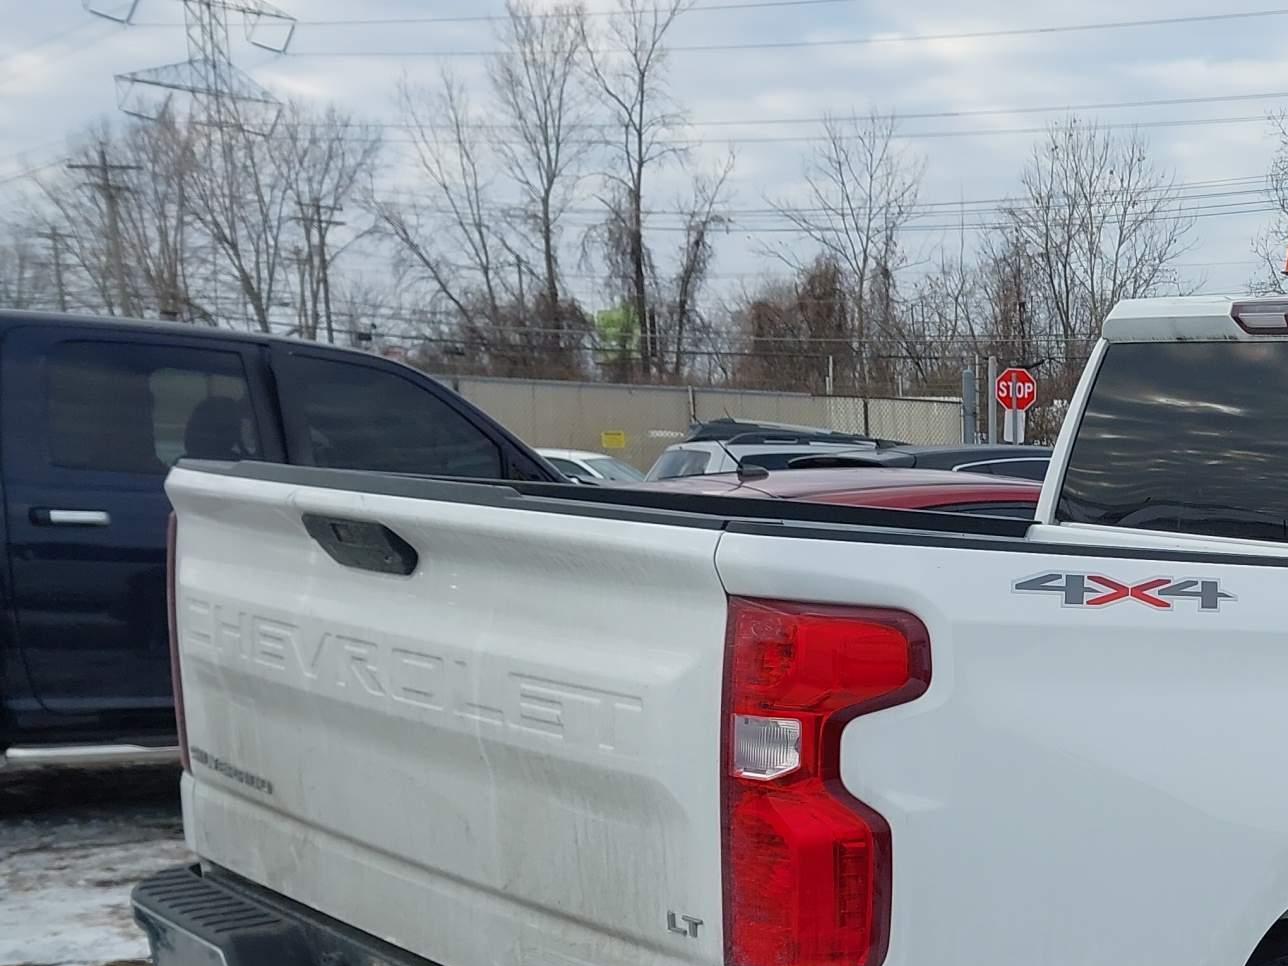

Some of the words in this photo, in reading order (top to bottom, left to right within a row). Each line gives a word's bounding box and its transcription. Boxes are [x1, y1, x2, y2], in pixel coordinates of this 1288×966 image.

[998, 380, 1033, 398] STOP
[185, 598, 644, 752] CHEVROLET
[667, 910, 704, 938] LT
